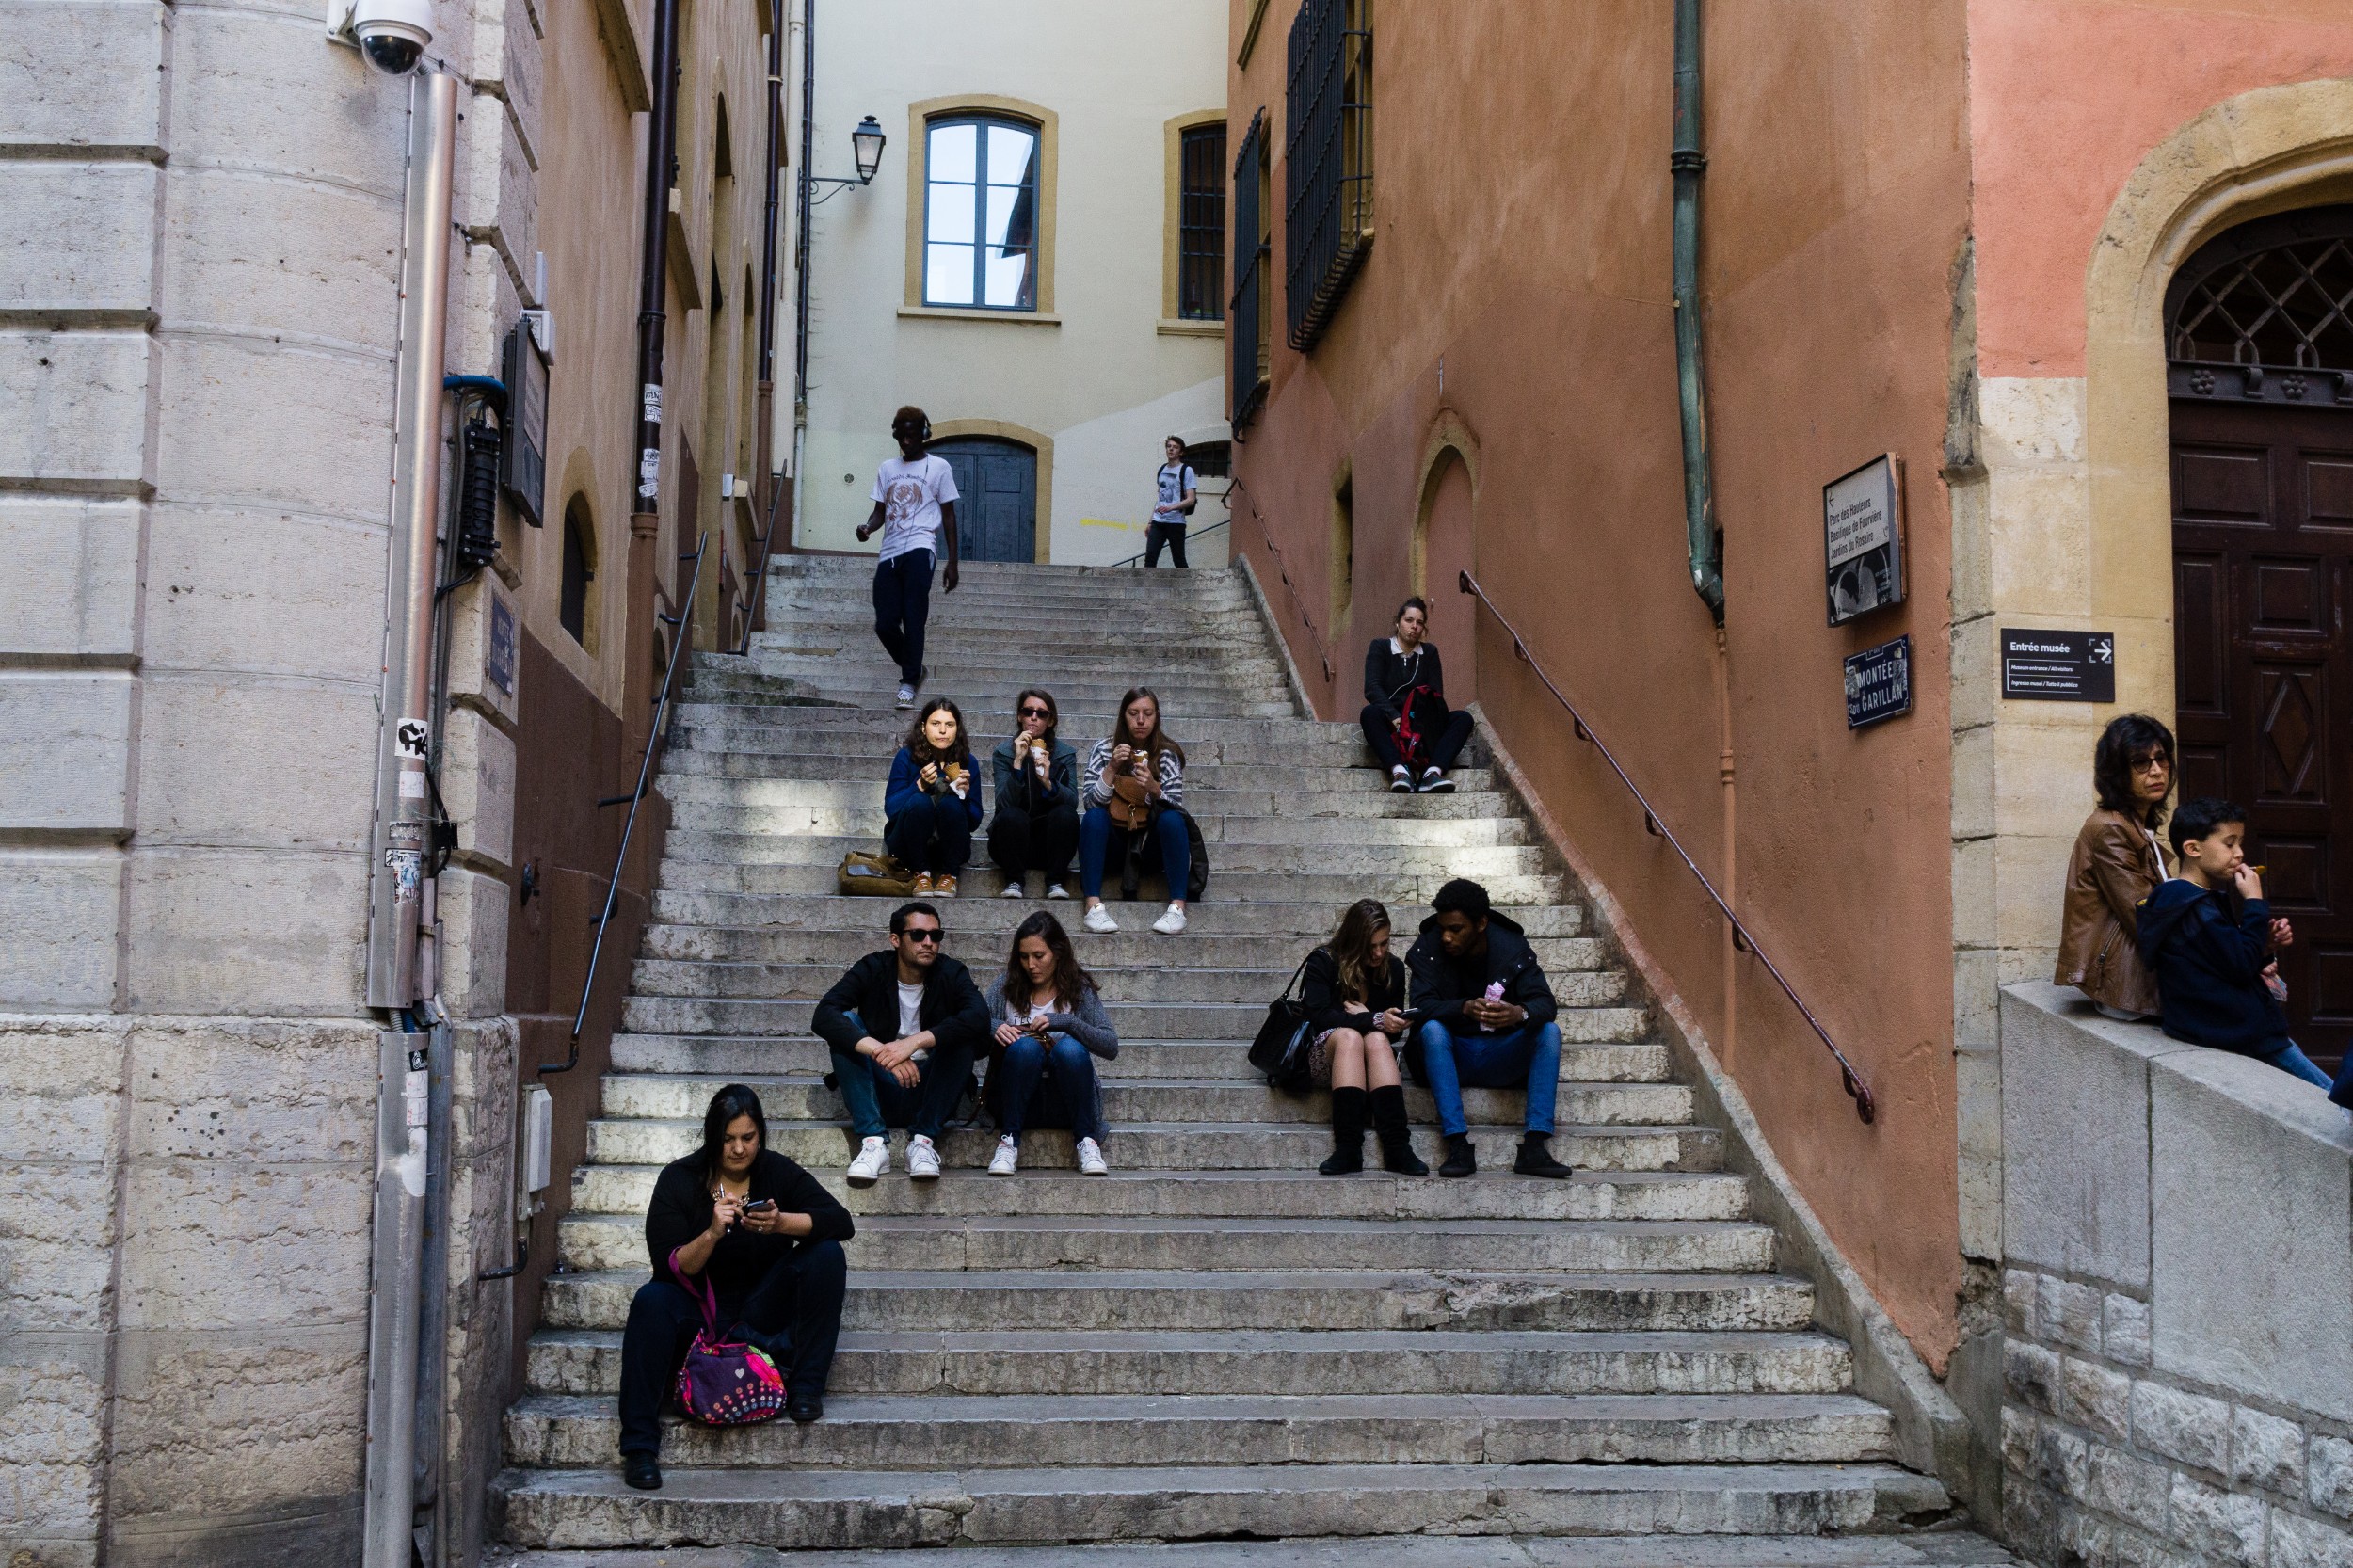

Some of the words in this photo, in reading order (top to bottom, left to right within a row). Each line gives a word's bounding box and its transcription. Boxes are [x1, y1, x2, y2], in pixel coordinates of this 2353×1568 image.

[1830, 514, 1840, 526] Parc
[1841, 509, 1849, 521] des
[1849, 498, 1871, 517] Hauteurs
[1830, 525, 1852, 543] Basilique
[1852, 520, 1859, 533] de
[1859, 509, 1882, 530] Fourvière
[1831, 544, 1849, 559] Jardins
[1849, 540, 1855, 552] du
[1855, 532, 1874, 549] Rosaire
[2009, 641, 2040, 651] Entrée
[2041, 643, 2071, 653] musée
[1857, 660, 1893, 688] MONTÉE
[1862, 683, 1903, 712] GARILLAN
